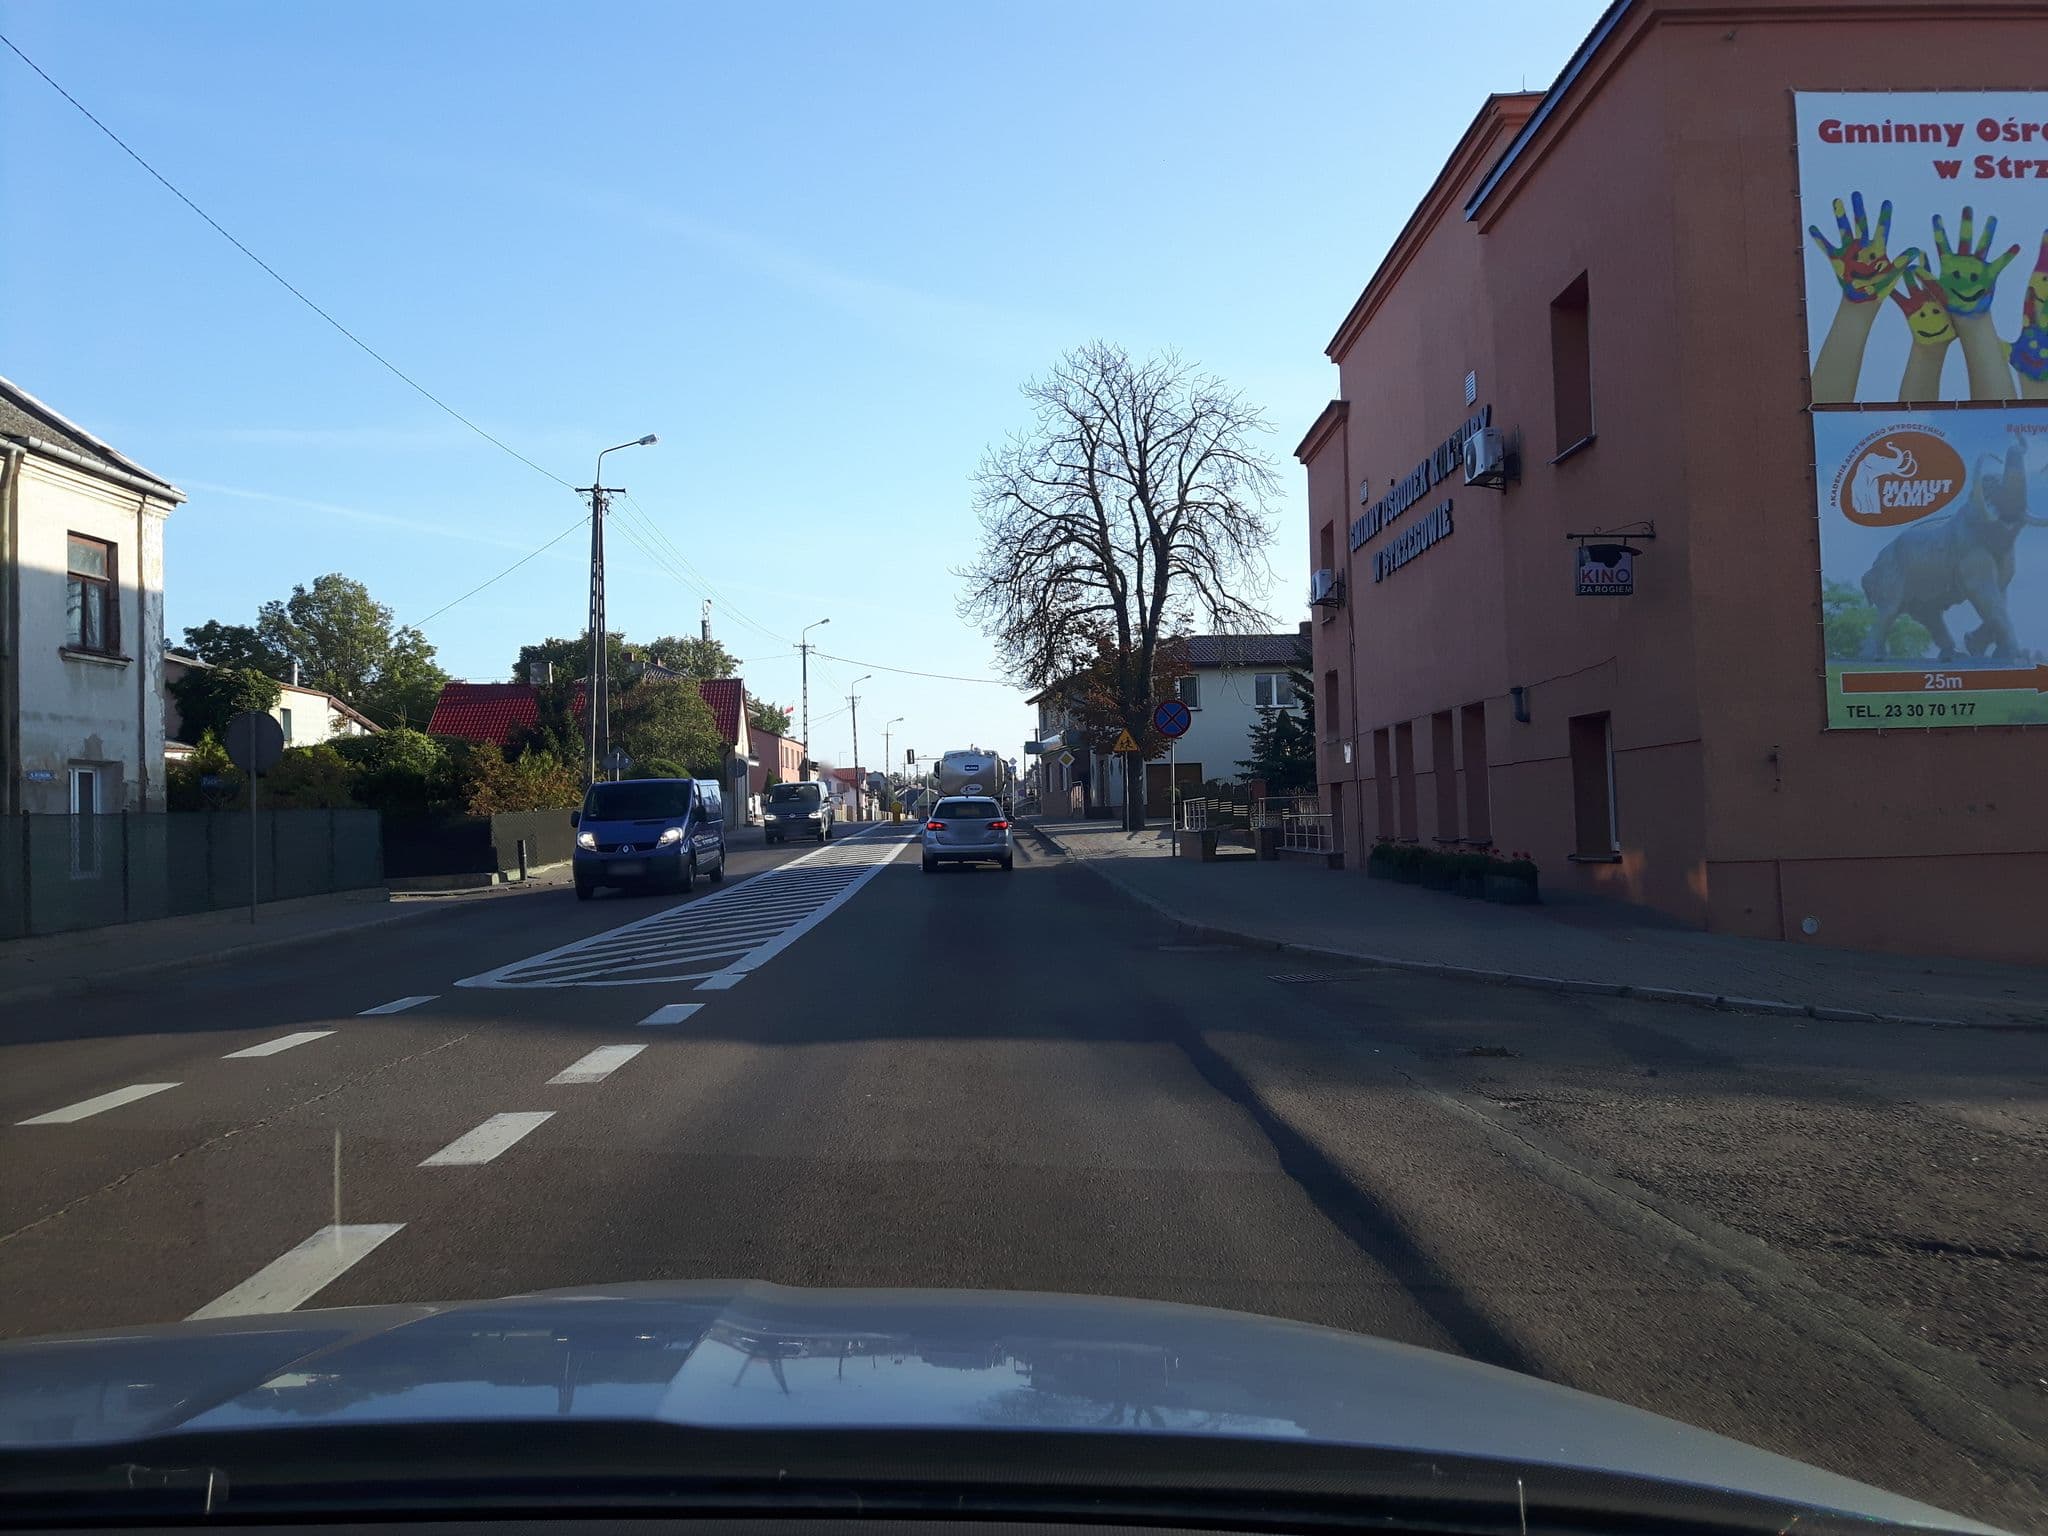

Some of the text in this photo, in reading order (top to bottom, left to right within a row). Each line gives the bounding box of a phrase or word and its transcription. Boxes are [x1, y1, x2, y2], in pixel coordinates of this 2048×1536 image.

[1818, 118, 1965, 148] Gminny
[1933, 155, 2048, 179] w Strz
[1883, 480, 1952, 495] MAMUT
[1882, 490, 1936, 507] CAMP
[1350, 502, 1382, 553] GMINNY
[1582, 568, 1630, 583] KINO
[1581, 585, 1632, 593] ZA ROGIEM
[1924, 673, 1962, 689] 25m
[1846, 702, 1976, 718] TEL. 23 30 70 177
